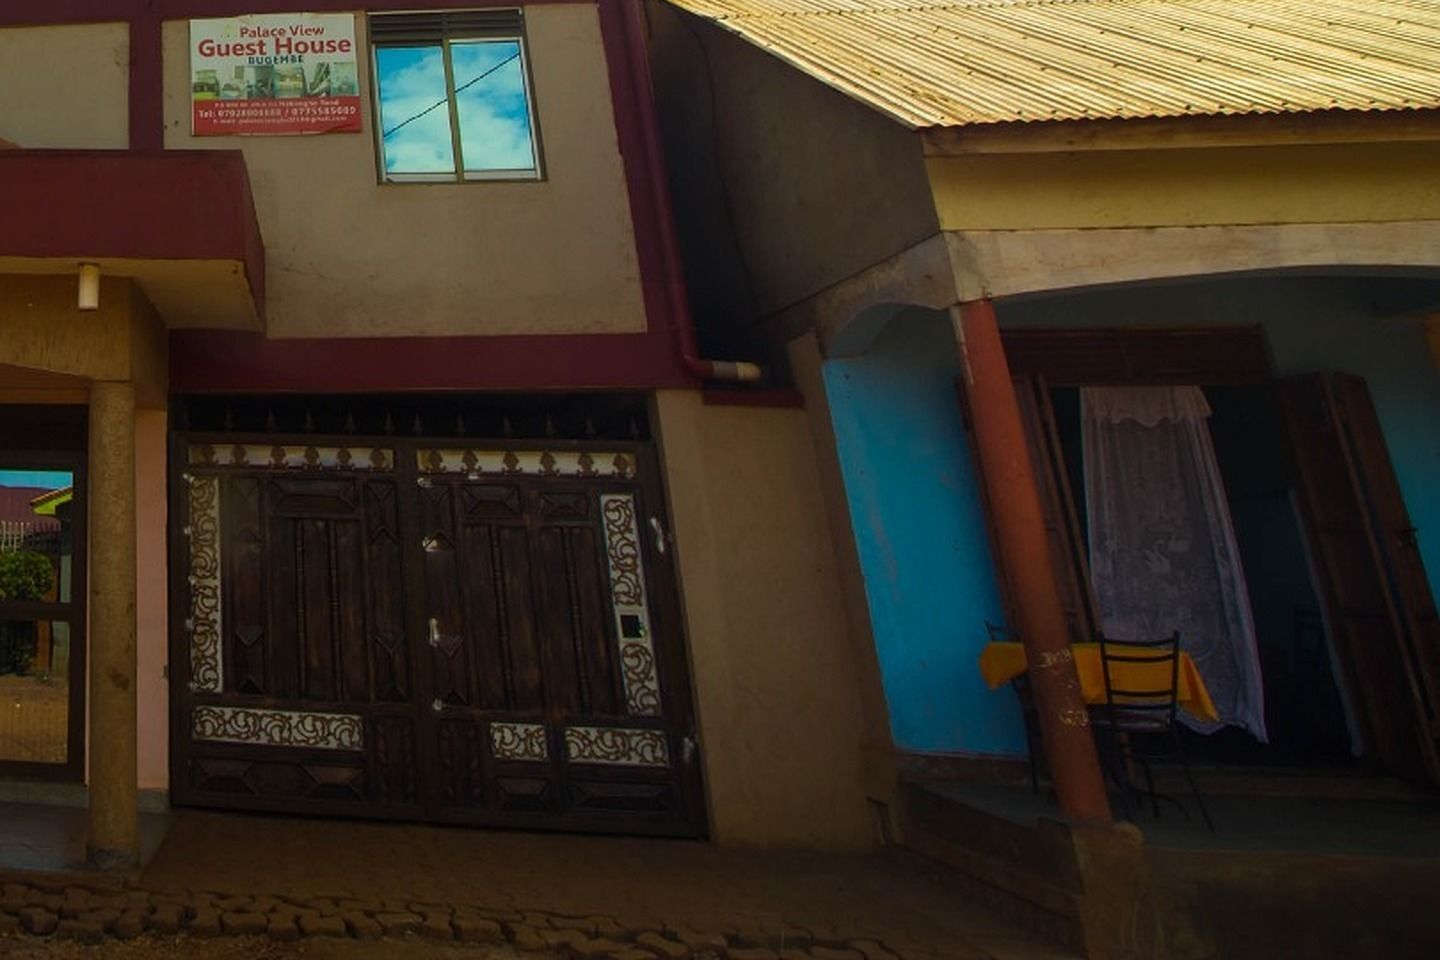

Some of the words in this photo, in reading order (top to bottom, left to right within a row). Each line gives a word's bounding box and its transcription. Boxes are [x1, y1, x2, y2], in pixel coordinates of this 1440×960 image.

[240, 26, 286, 39] Palace
[289, 25, 325, 36] View
[198, 39, 266, 58] Guest
[275, 37, 352, 55] House
